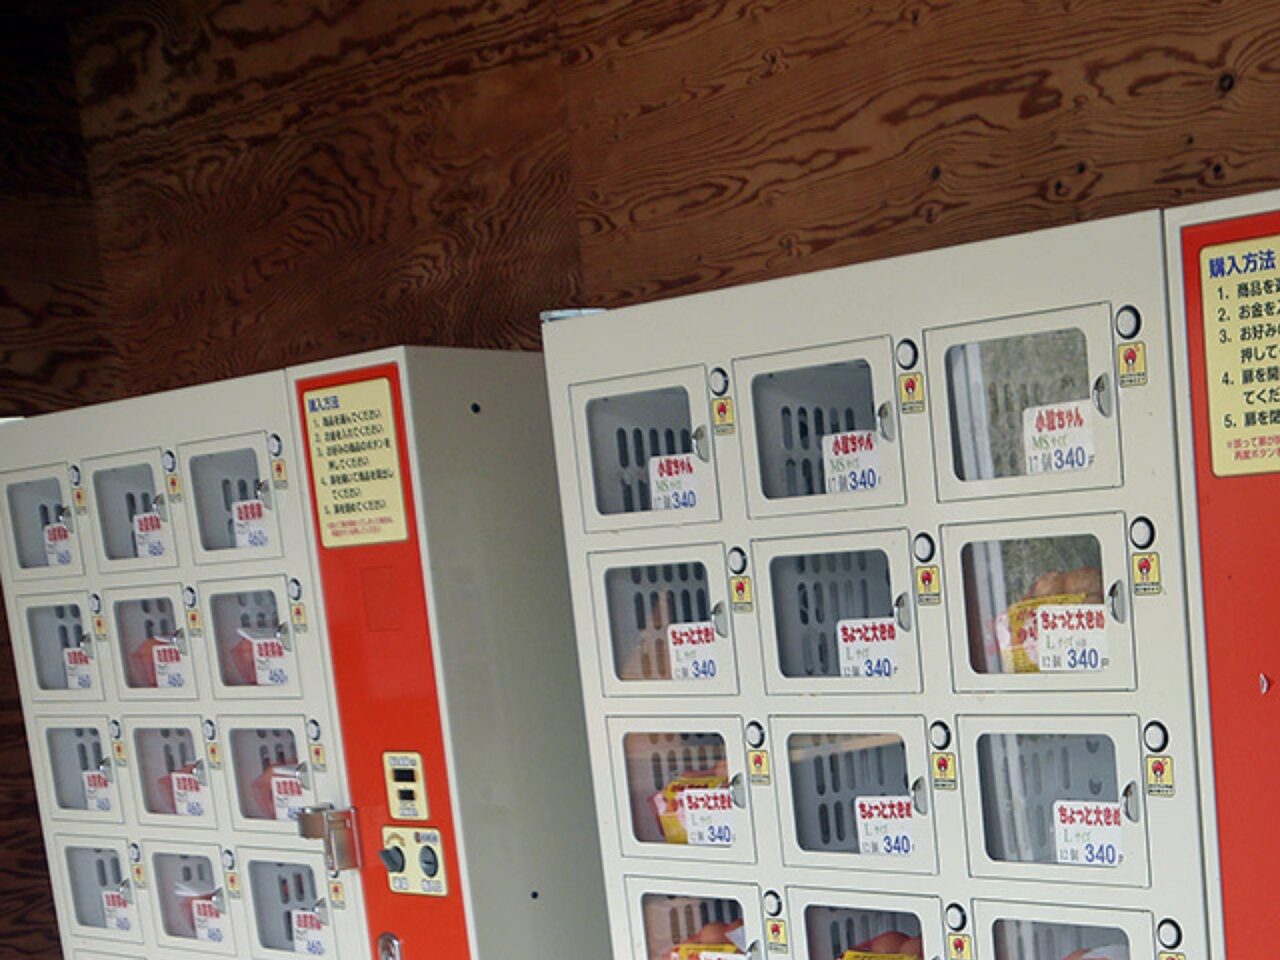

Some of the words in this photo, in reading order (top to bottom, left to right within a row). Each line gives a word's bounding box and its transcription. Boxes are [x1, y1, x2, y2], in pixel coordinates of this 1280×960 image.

[1209, 249, 1276, 278] 購入方法
[1218, 287, 1229, 300] 1.
[1218, 308, 1230, 322] 2.
[1219, 330, 1231, 343] 3.
[1222, 372, 1234, 385] 4.
[1224, 415, 1236, 428] 5.
[1041, 610, 1104, 630] ちょっと大きめ
[671, 628, 715, 646] ちょっと大き
[842, 624, 896, 643] ちょっと大きめ
[1058, 807, 1121, 827] ちょっと大きめ
